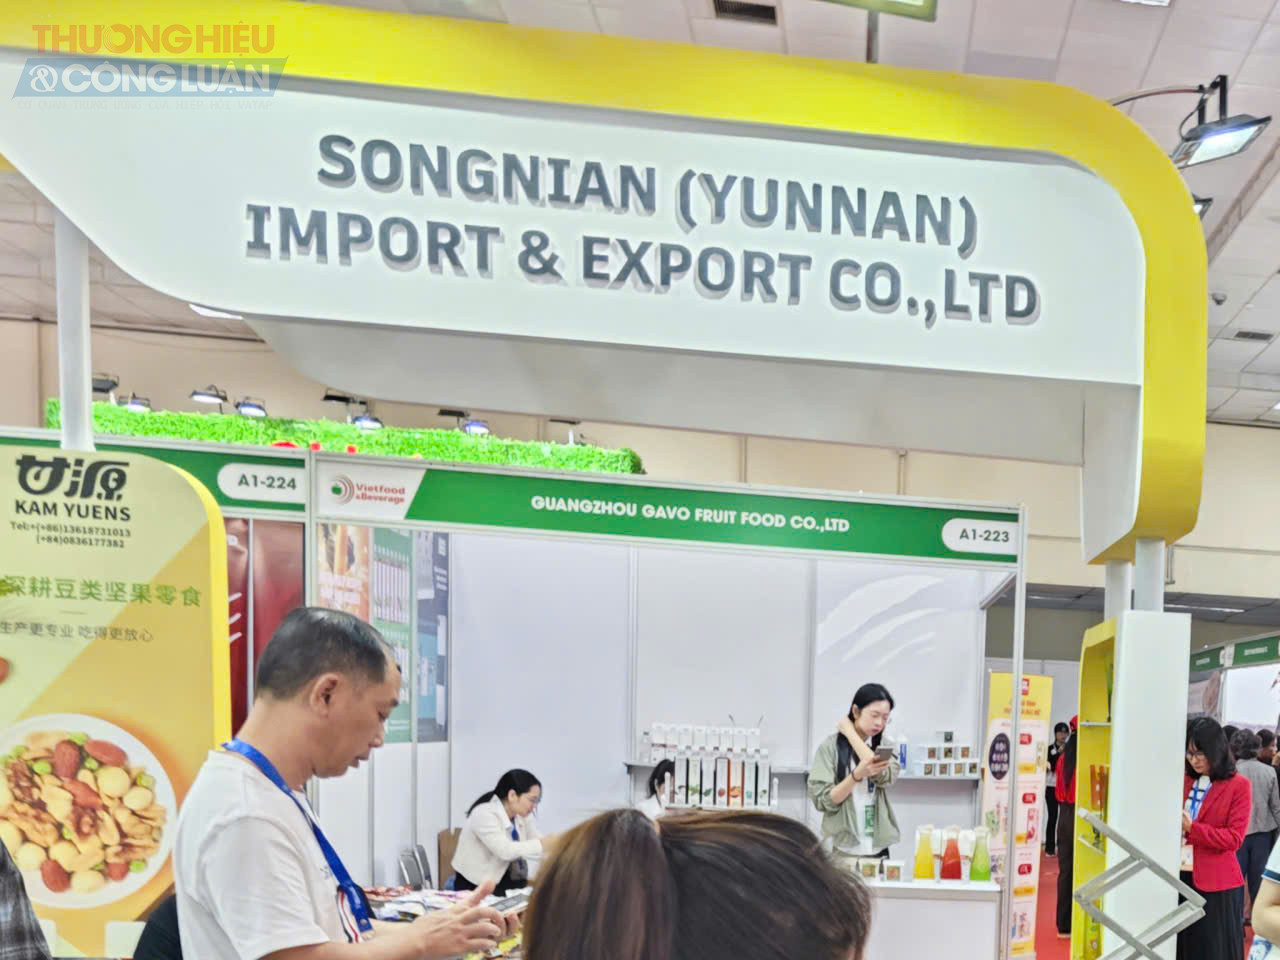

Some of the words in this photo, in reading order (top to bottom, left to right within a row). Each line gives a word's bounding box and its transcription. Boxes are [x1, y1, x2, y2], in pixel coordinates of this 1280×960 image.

[318, 133, 657, 214] SONGNIAN
[676, 168, 977, 259] (YUNNAN)
[245, 203, 501, 278] IMPORT
[517, 229, 564, 284] &
[581, 234, 812, 306] EXPORT
[829, 258, 1040, 329] CO.,LTD
[237, 473, 298, 491] A1-224
[355, 483, 406, 496] Vietfood
[15, 499, 58, 517] KAM
[64, 503, 131, 521] YUENS
[531, 494, 638, 518] GUANGZHOU
[641, 503, 691, 521] GAVO
[694, 507, 737, 525] FRUIT
[740, 510, 787, 529] FOOD
[790, 514, 850, 533] CO.,LTD
[959, 527, 1010, 543] A1-223
